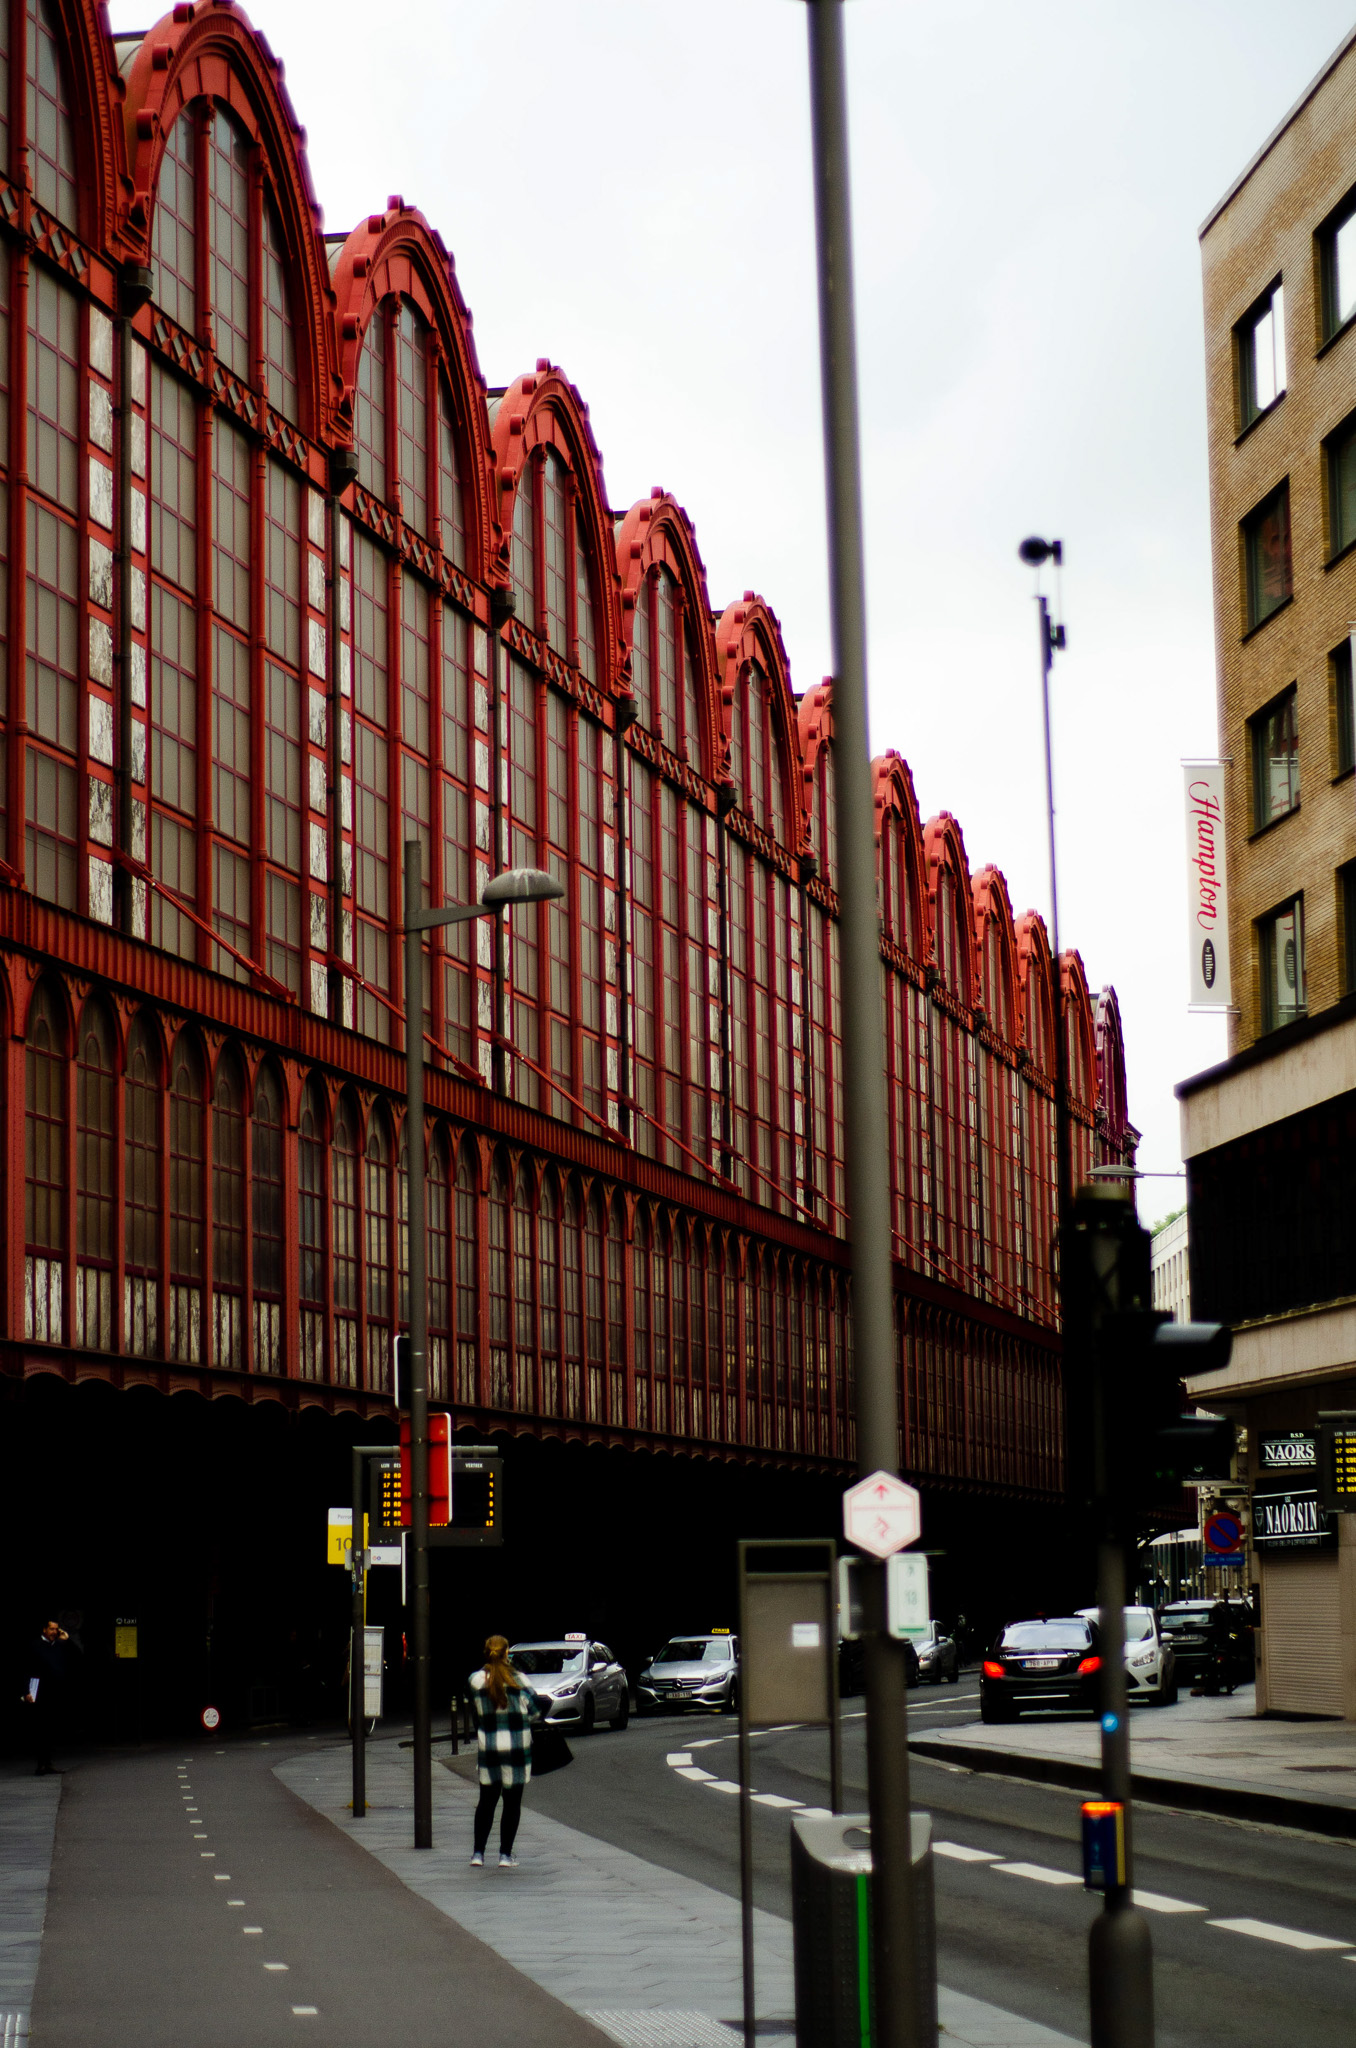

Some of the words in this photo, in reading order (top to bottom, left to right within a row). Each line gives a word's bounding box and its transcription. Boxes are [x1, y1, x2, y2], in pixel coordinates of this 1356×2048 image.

[1188, 781, 1223, 930] Hampton
[1205, 954, 1213, 981] Hilton
[1265, 1501, 1317, 1534] NAORSIN
